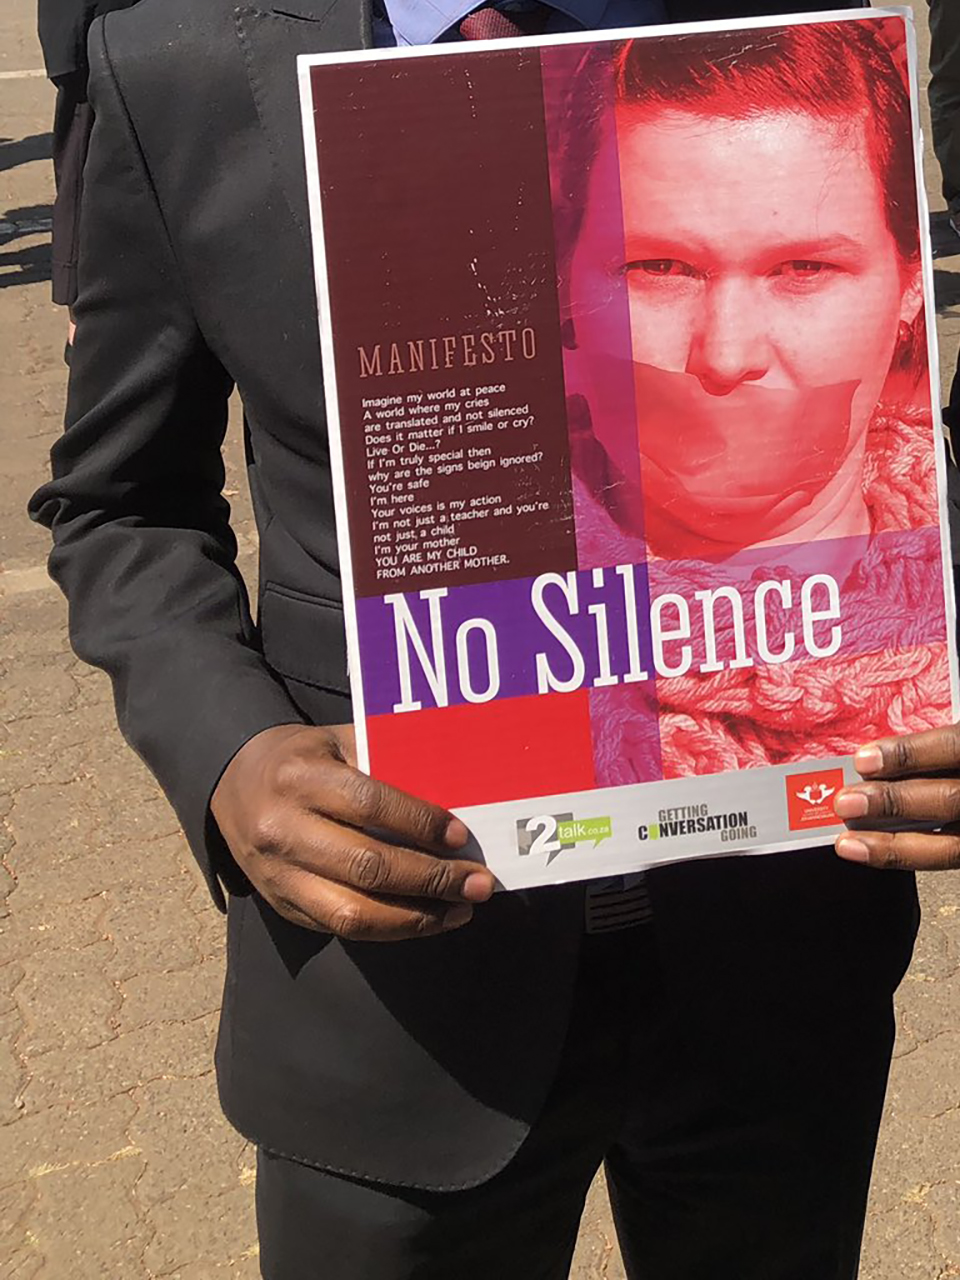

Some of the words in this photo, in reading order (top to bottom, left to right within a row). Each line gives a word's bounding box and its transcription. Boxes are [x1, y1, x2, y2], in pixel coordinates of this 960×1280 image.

[357, 327, 536, 378] MANIFESTO
[361, 395, 402, 408] Imagine
[406, 394, 423, 404] my
[426, 387, 456, 400] world
[459, 387, 471, 397] at
[475, 384, 506, 396] peace
[363, 410, 372, 420] A
[375, 406, 405, 418] world
[408, 404, 440, 415] where
[444, 401, 461, 412] my
[464, 398, 489, 408] cries
[364, 423, 381, 433] are
[385, 414, 438, 430] translated
[442, 411, 461, 423] and
[465, 410, 483, 420] not
[487, 404, 529, 418] silenced
[364, 434, 392, 445] Does
[395, 432, 404, 441] it
[407, 428, 444, 440] matter
[447, 424, 455, 435] if
[459, 424, 463, 434] I
[466, 421, 493, 433] smile
[497, 420, 508, 429] or
[512, 416, 534, 428] cry?
[366, 447, 388, 457] Live
[391, 443, 405, 454] Or
[367, 458, 374, 469] If
[378, 458, 396, 468] I'm
[399, 454, 424, 466] truly
[428, 448, 463, 463] special
[467, 447, 491, 457] then
[368, 471, 390, 482] why
[394, 469, 410, 479] are
[414, 466, 432, 476] the
[436, 463, 463, 475] signs
[467, 459, 496, 470] beign
[499, 451, 543, 468] ignored?
[369, 482, 403, 493] You're
[407, 477, 429, 489] safe
[370, 496, 387, 506] I'm
[390, 493, 414, 503] here
[370, 508, 395, 518] Your
[399, 503, 433, 515] voices
[436, 501, 445, 510] is
[449, 499, 466, 510] my
[469, 495, 501, 507] action
[372, 520, 389, 530] I'm
[393, 518, 411, 528] not
[439, 514, 446, 523] a
[450, 508, 489, 521] teacher
[493, 504, 512, 516] and
[516, 501, 549, 515] you're
[373, 532, 391, 543] not
[420, 529, 426, 537] a
[430, 523, 455, 536] child
[374, 545, 391, 555] I'm
[394, 542, 418, 555] your
[422, 537, 460, 549] mother
[375, 555, 398, 567] YOU
[401, 552, 423, 564] ARE
[426, 549, 442, 561] MY
[446, 545, 477, 559] CHILD
[376, 566, 406, 579] FROM
[409, 560, 460, 575] ANOTHER
[464, 554, 510, 568] MOTHER.
[384, 586, 500, 714] No
[530, 563, 842, 695] Silence
[658, 804, 708, 822] GETTING
[720, 826, 758, 843] GOING
